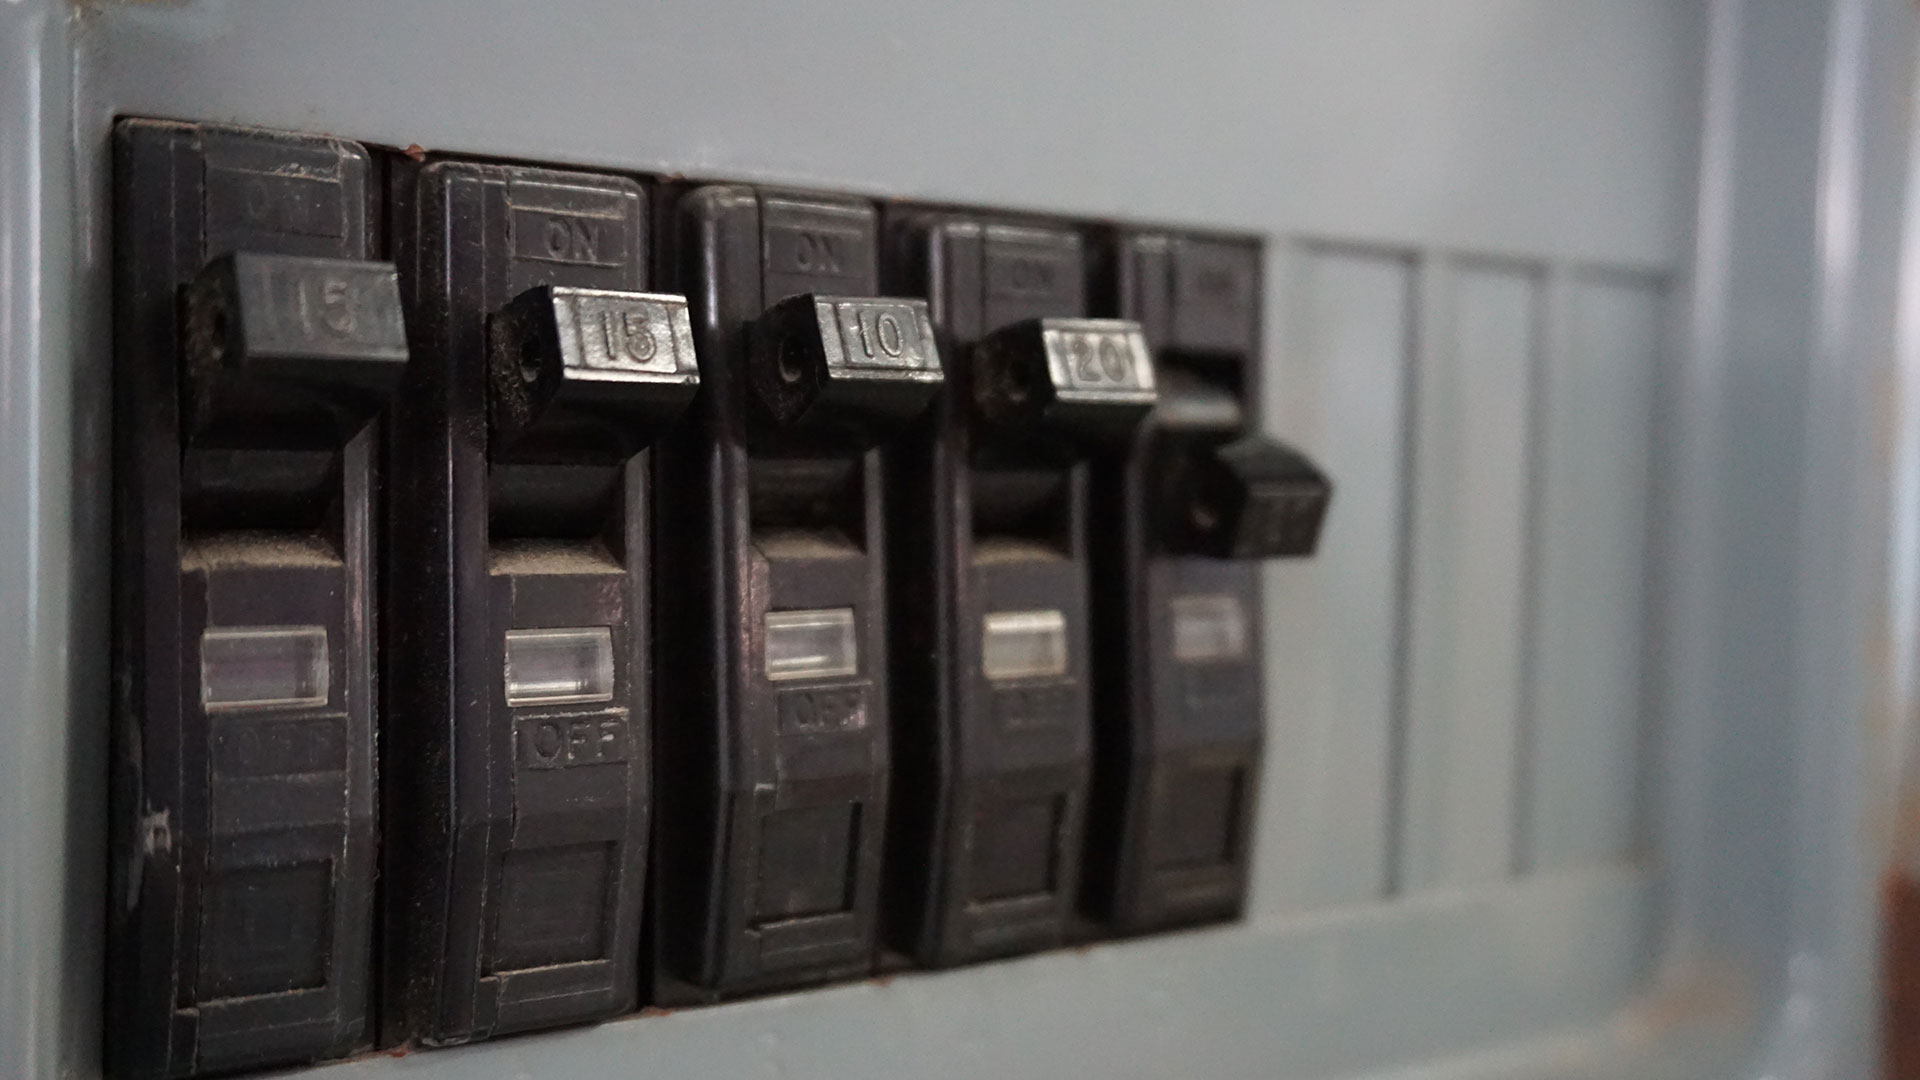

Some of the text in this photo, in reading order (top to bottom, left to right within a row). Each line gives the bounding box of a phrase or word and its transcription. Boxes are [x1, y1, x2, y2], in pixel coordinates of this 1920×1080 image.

[545, 216, 599, 261] ON
[797, 231, 843, 272] ON
[298, 279, 360, 338] 15
[600, 307, 658, 363] 15
[856, 311, 904, 358] 10
[1072, 337, 1128, 382] 20
[533, 720, 620, 761] OFF
